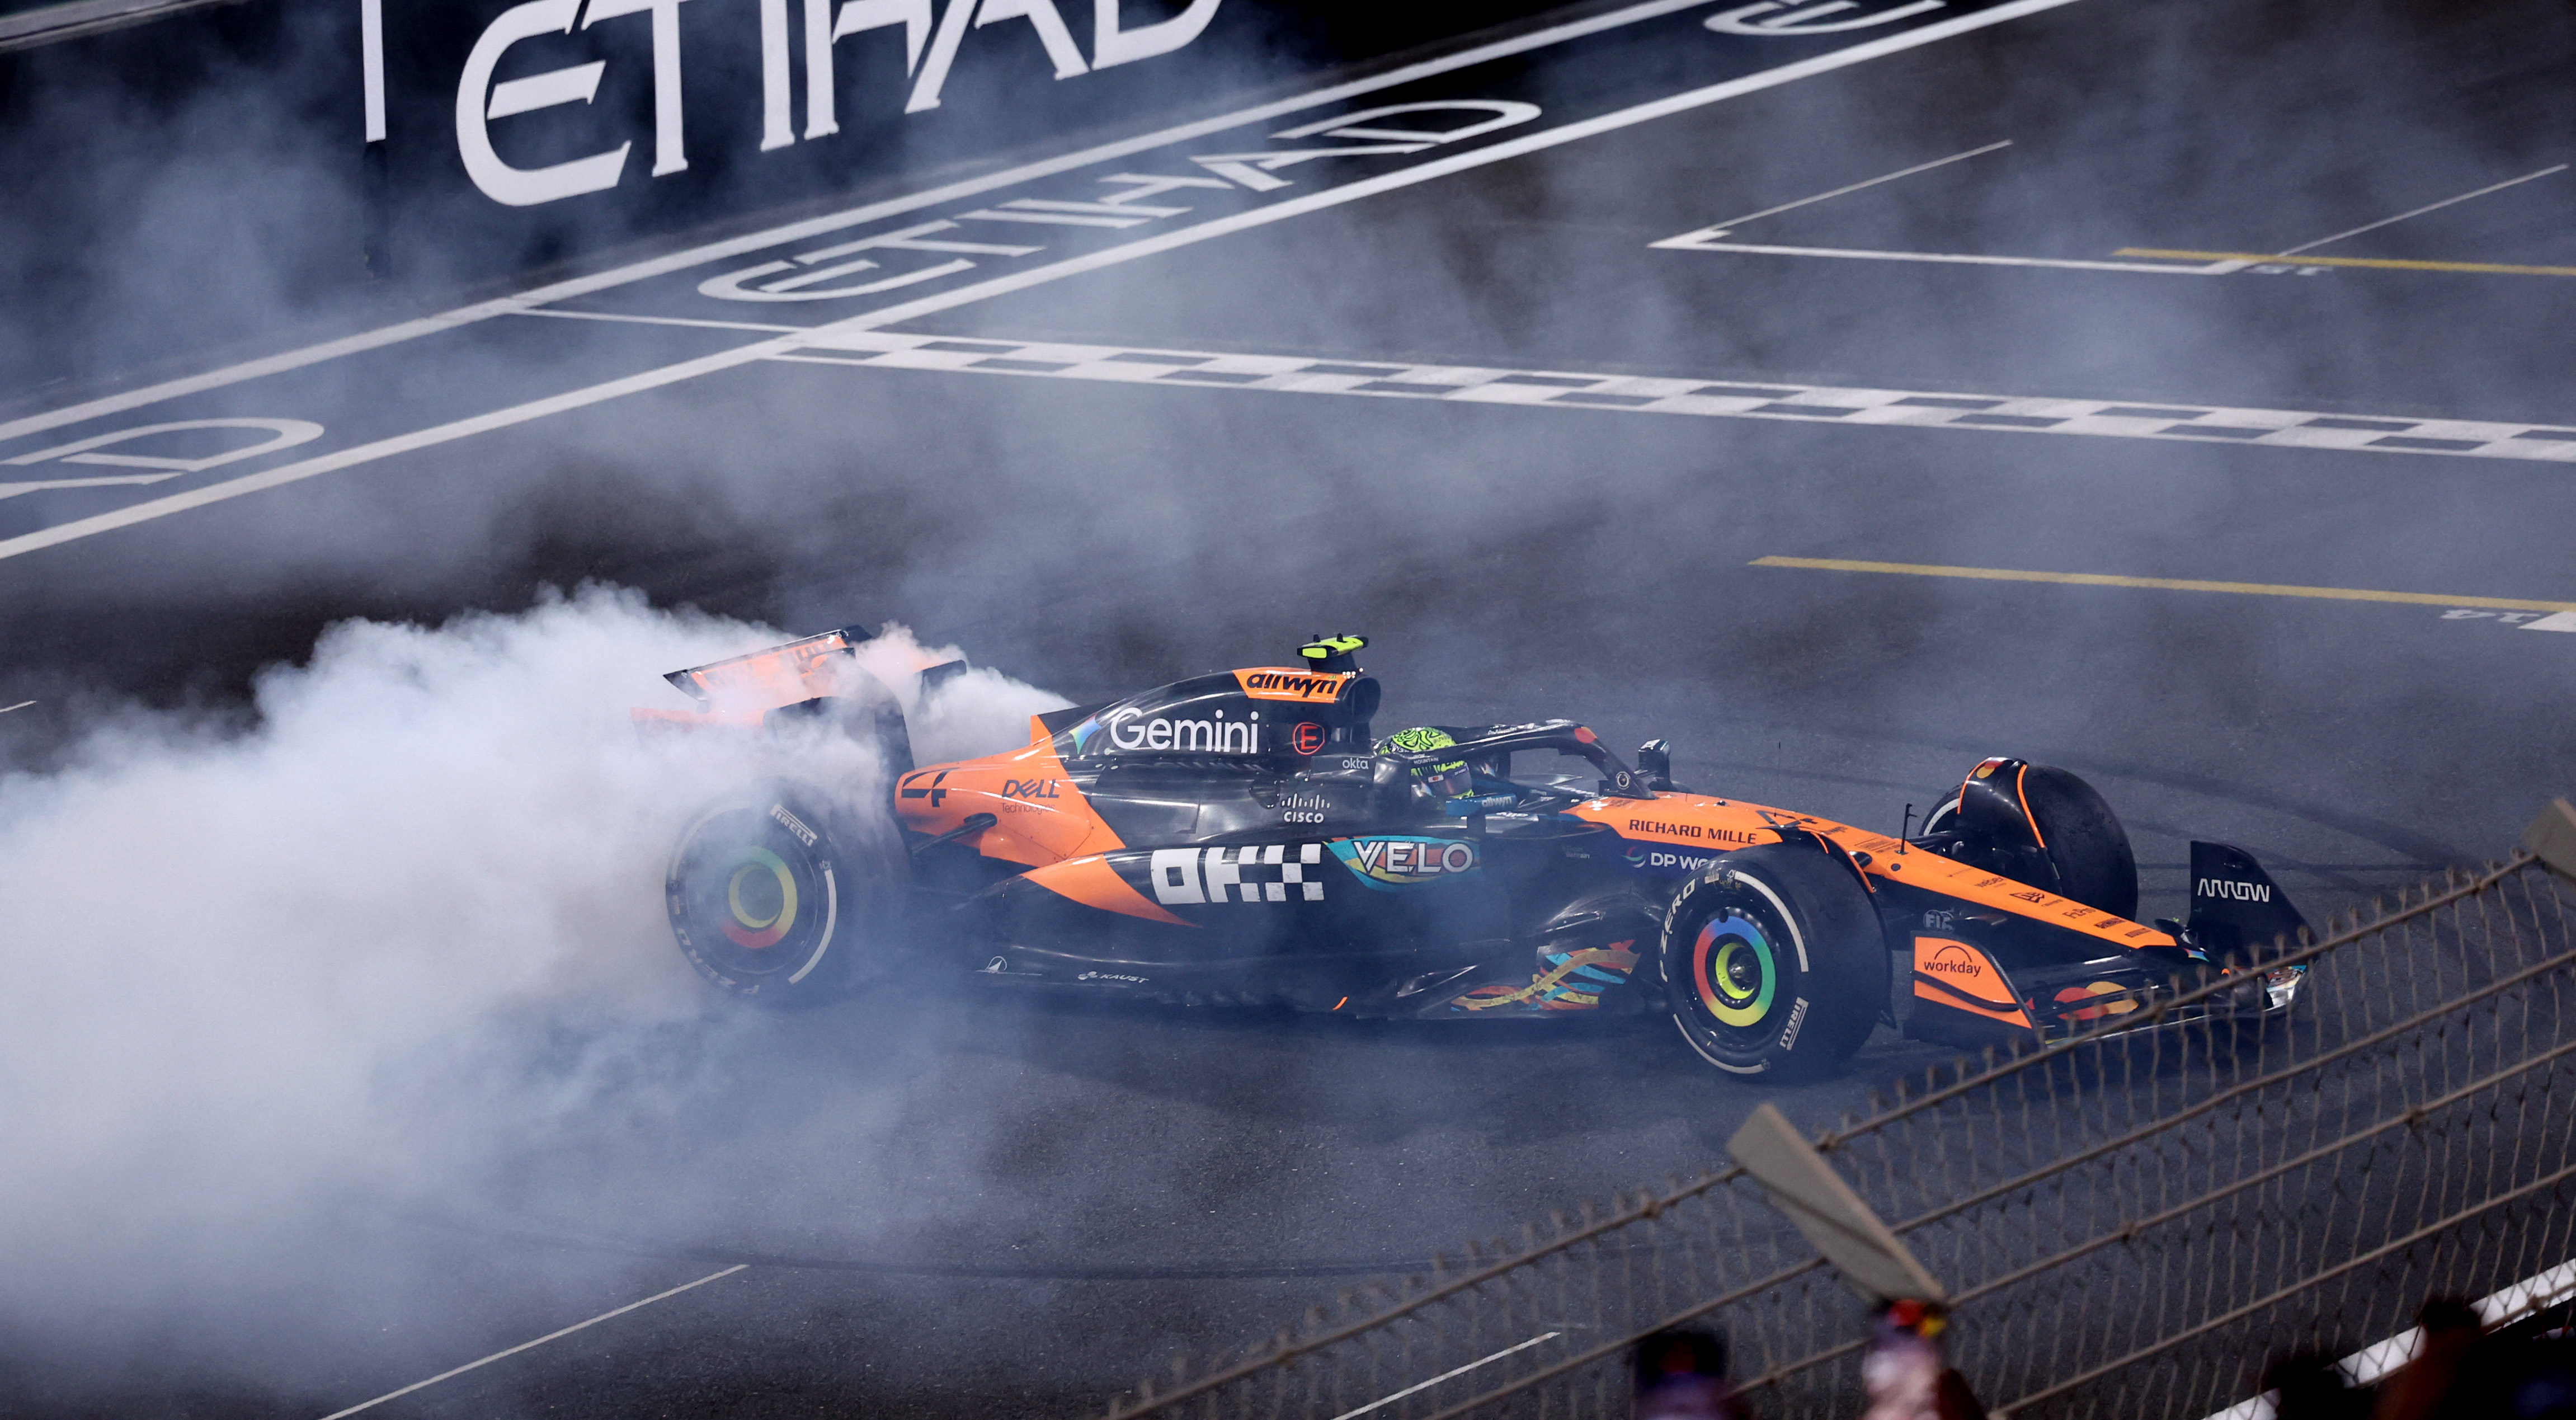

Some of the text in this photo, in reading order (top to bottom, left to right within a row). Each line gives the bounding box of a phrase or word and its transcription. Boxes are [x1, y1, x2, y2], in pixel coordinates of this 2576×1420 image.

[698, 100, 1542, 302] ETIHAD
[1247, 673, 1338, 698] allwyn
[1110, 707, 1260, 754] Gemini
[1343, 758, 1369, 769] okta
[1001, 779, 1059, 798] DELL
[769, 803, 818, 847] PIRELLI
[1629, 819, 1757, 844] RICHARD MILLE
[1353, 840, 1474, 874] VELO
[1650, 852, 1676, 867] DP
[1150, 844, 1325, 905] OKX
[2197, 878, 2270, 902] ARROW
[1660, 878, 1697, 954] ZERO
[1099, 973, 1149, 984] KAUST
[1924, 960, 1981, 977] workday
[1779, 996, 1810, 1051] PIRELLI
